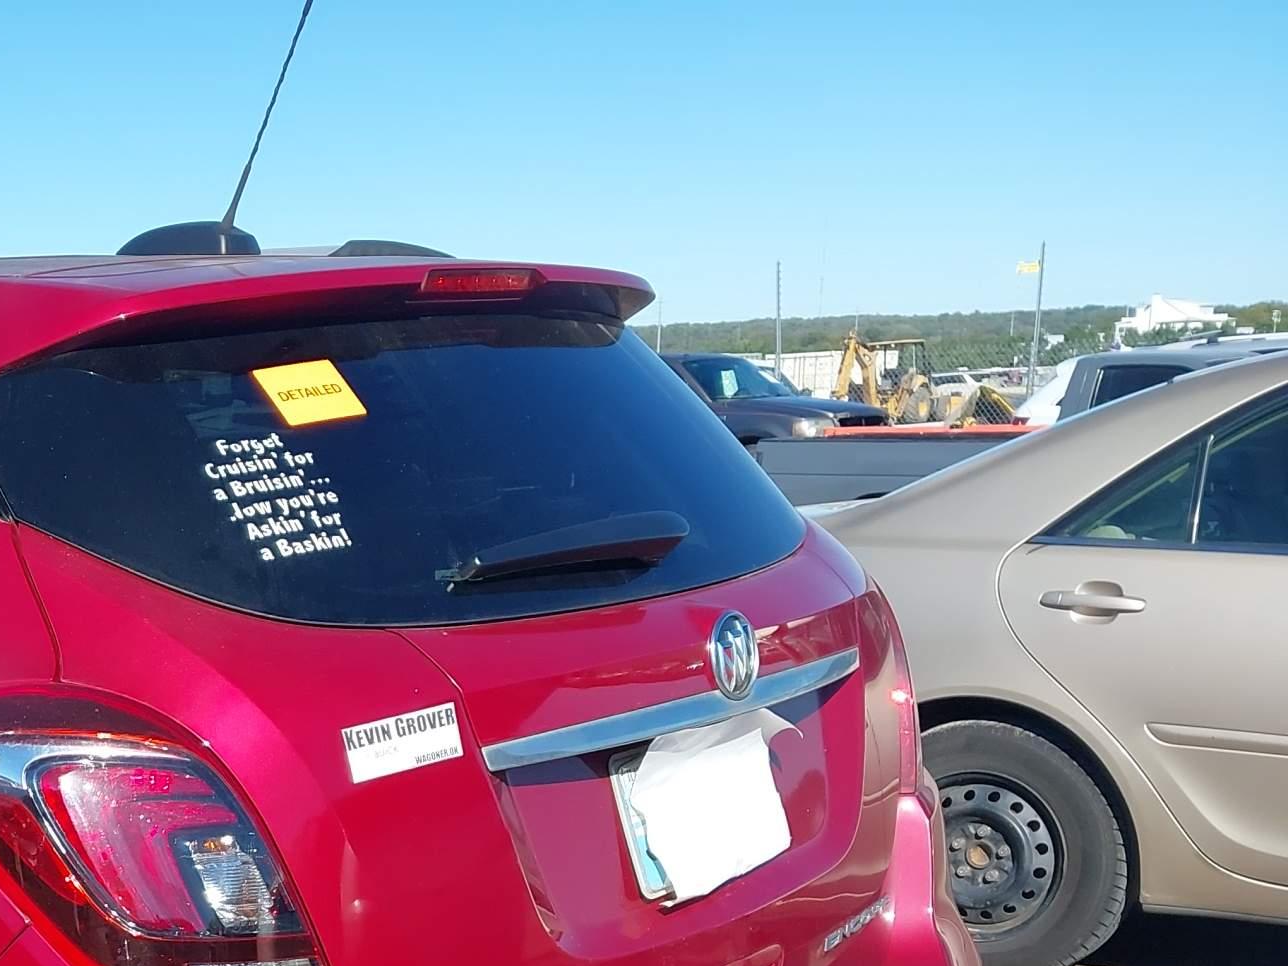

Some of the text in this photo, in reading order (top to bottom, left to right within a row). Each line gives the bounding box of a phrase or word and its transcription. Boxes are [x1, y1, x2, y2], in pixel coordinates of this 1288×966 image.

[277, 383, 343, 402] DETAILED
[215, 432, 284, 456] Forget
[204, 451, 314, 479] Cruisin' for
[213, 487, 229, 501] a
[229, 468, 305, 497] Bruisin'
[276, 488, 339, 516] you're
[310, 510, 342, 528] for
[260, 527, 353, 561] a Baskin!
